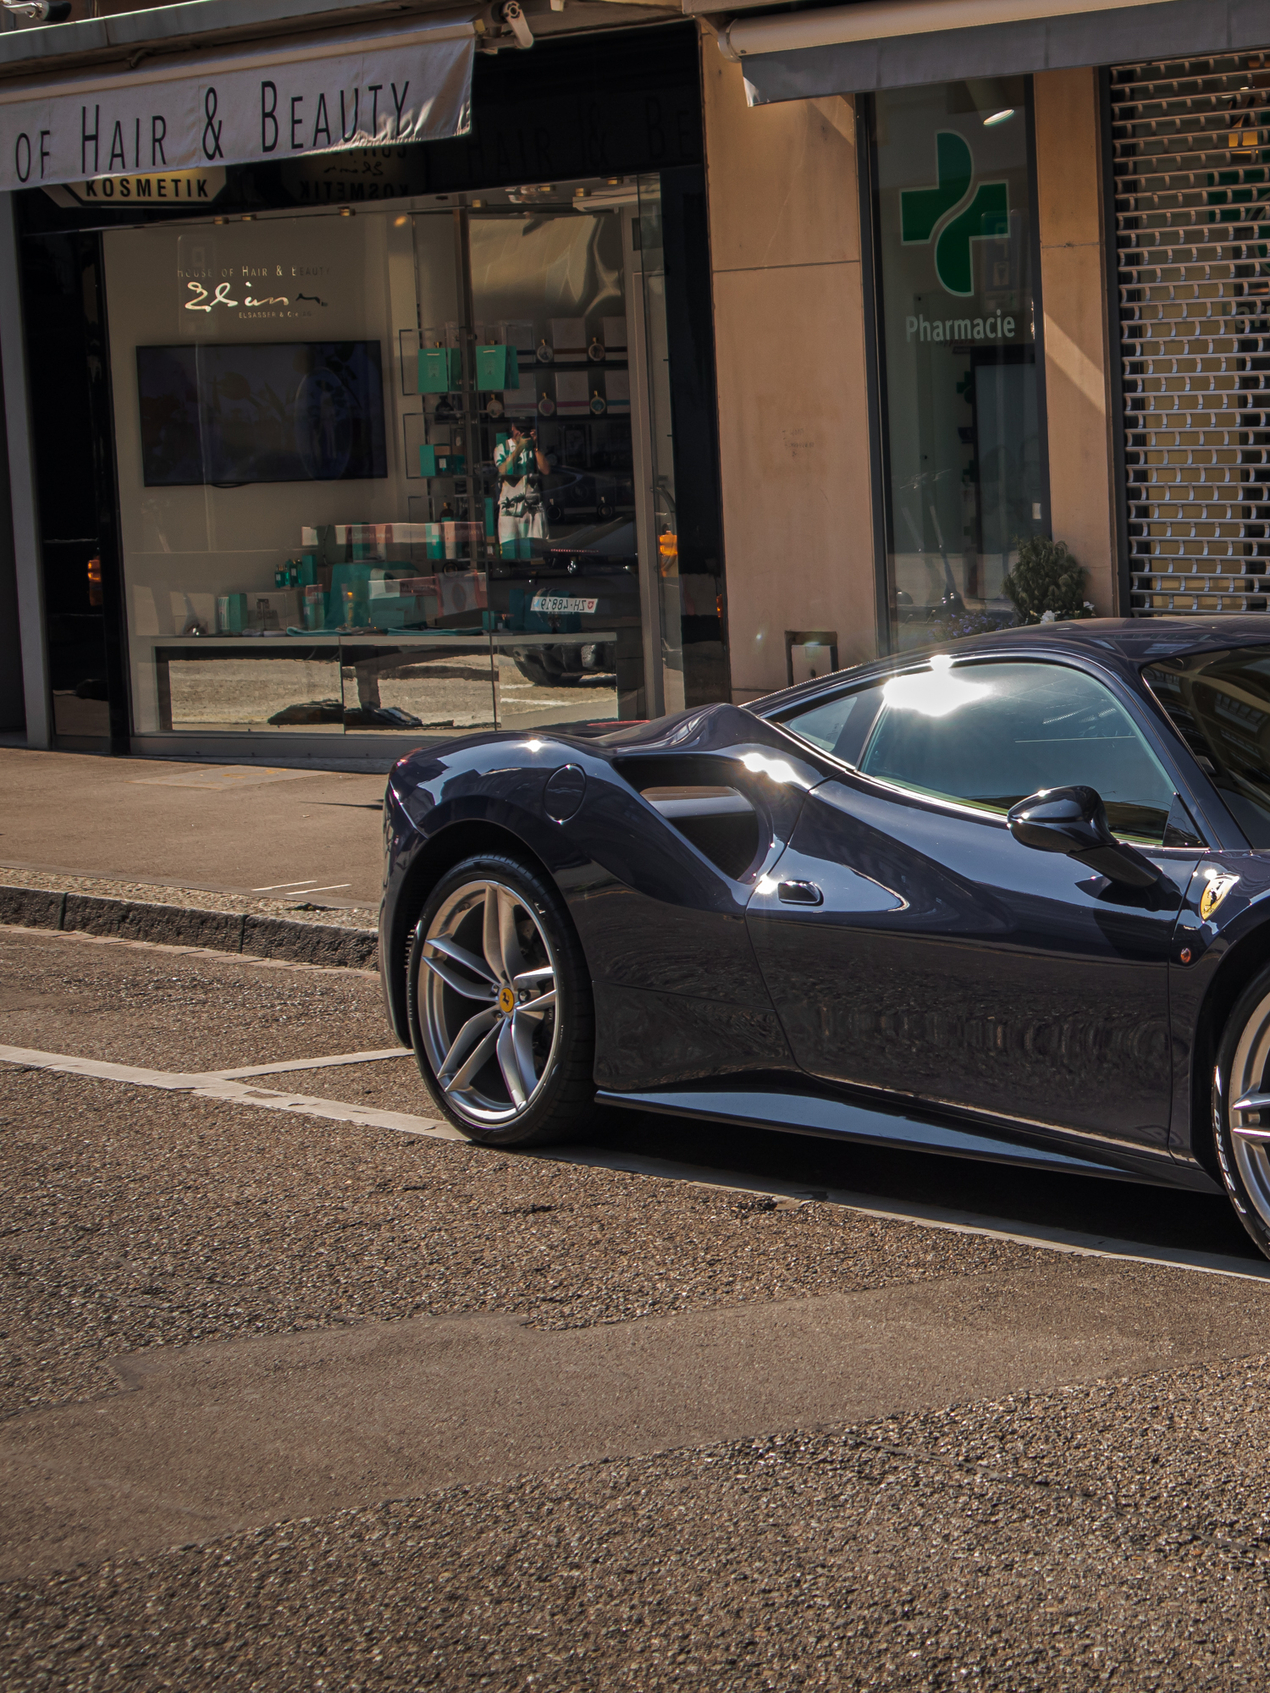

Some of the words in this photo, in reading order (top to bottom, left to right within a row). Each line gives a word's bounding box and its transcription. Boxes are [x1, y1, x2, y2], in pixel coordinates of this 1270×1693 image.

[15, 130, 50, 183] OF
[202, 87, 224, 161] &
[85, 178, 208, 198] KOSMETIK
[221, 267, 234, 277] OF
[276, 264, 283, 277] &
[905, 309, 1015, 342] Pharmacie
[1213, 1108, 1236, 1192] ZERO
